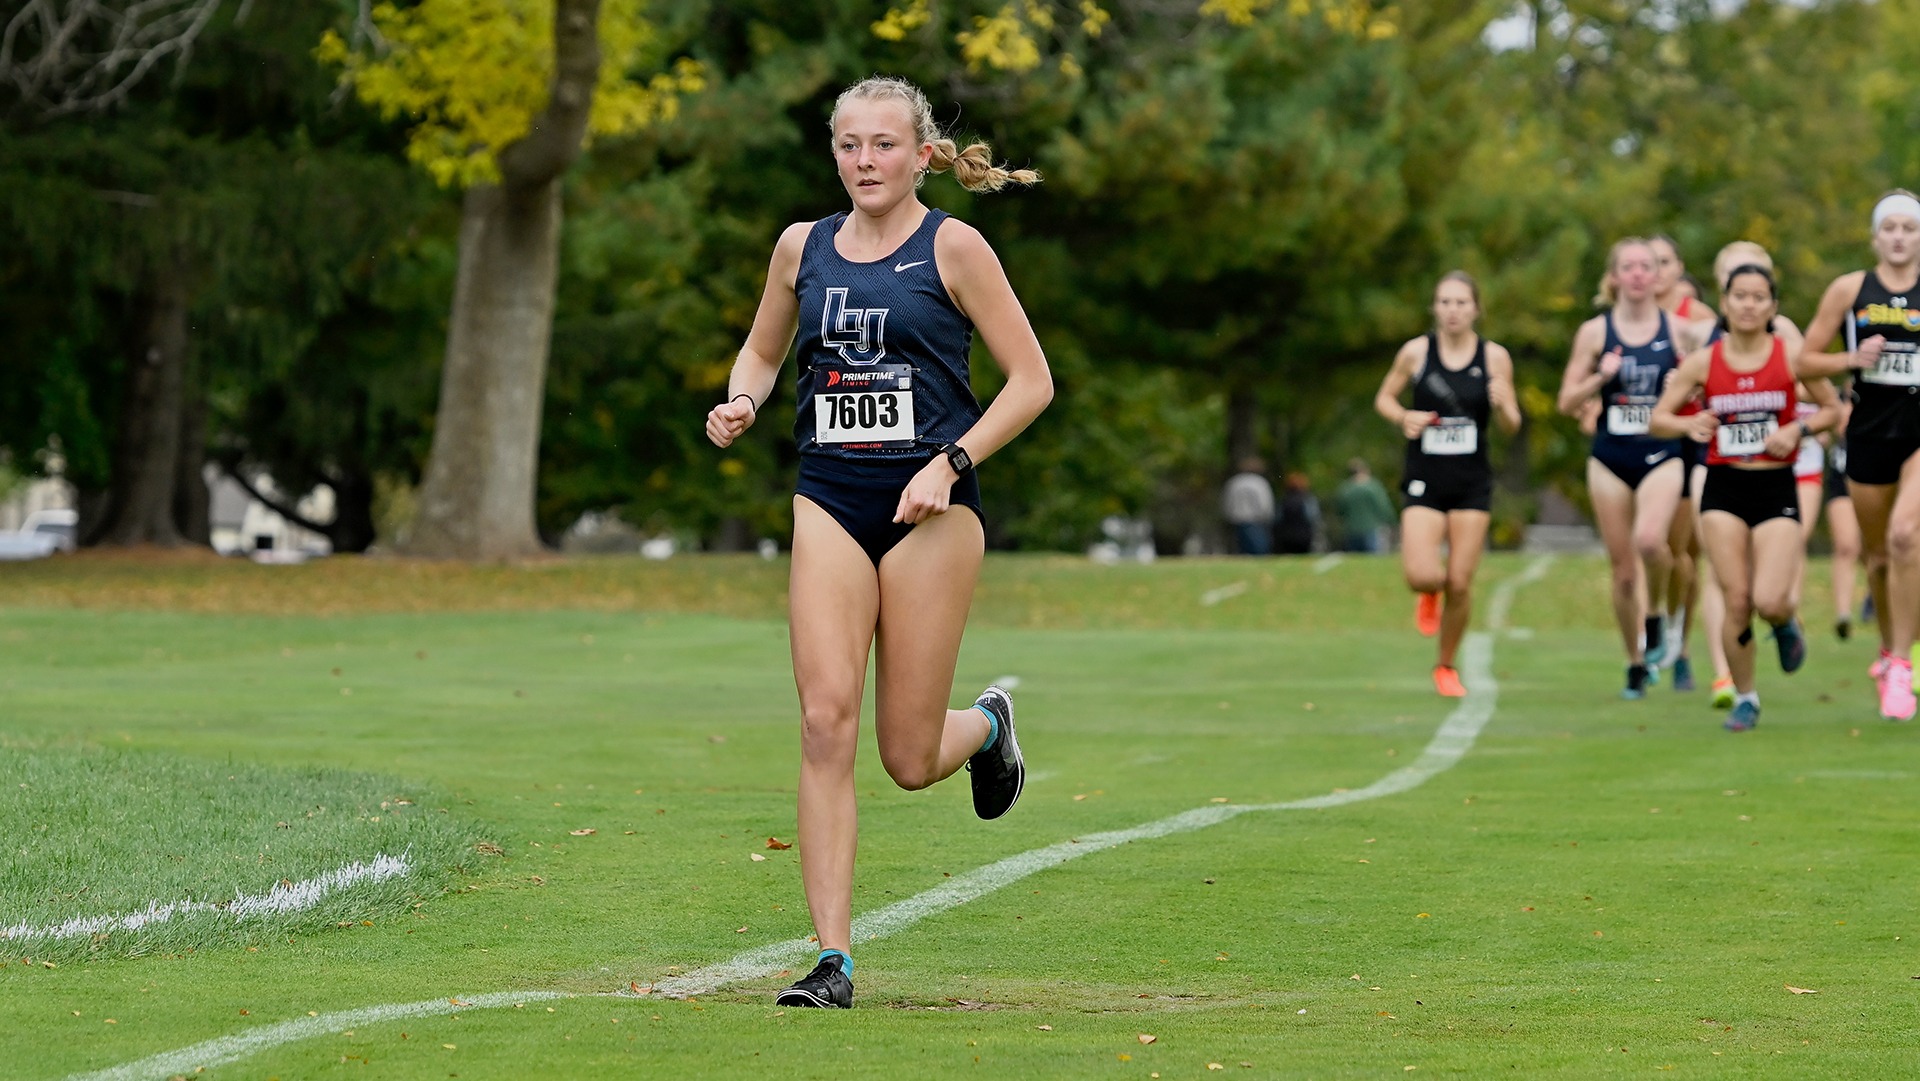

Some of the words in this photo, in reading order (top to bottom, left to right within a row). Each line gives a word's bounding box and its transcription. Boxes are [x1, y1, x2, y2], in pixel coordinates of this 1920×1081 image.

[821, 287, 889, 366] LU
[841, 371, 896, 381] PRIMETIME
[825, 393, 899, 430] 7603
[1618, 404, 1655, 424] 760
